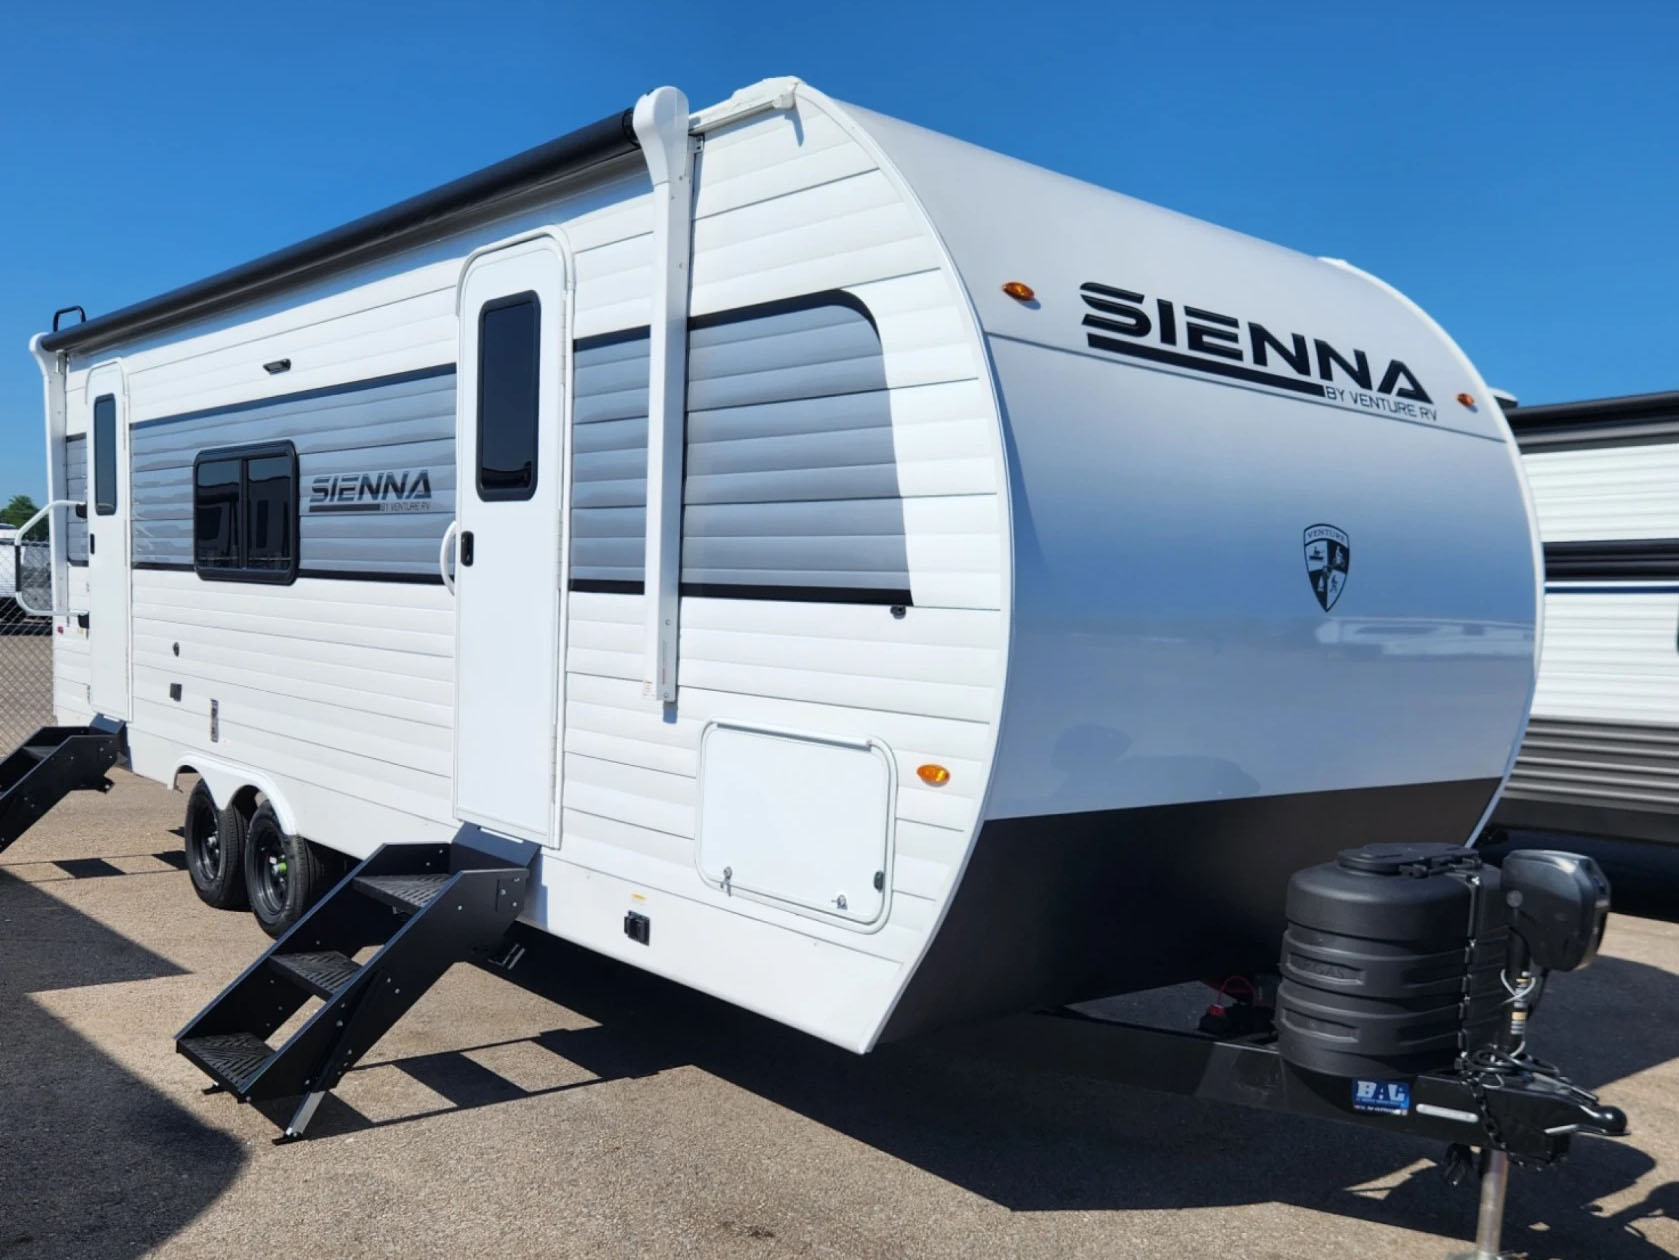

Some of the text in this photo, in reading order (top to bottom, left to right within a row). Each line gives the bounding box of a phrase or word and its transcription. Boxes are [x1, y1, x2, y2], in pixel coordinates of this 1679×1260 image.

[1079, 281, 1434, 405] SIENNA
[1325, 385, 1438, 421] BY VENTURE RV
[309, 470, 432, 503] SIENNA
[1307, 529, 1344, 542] VENTURE
